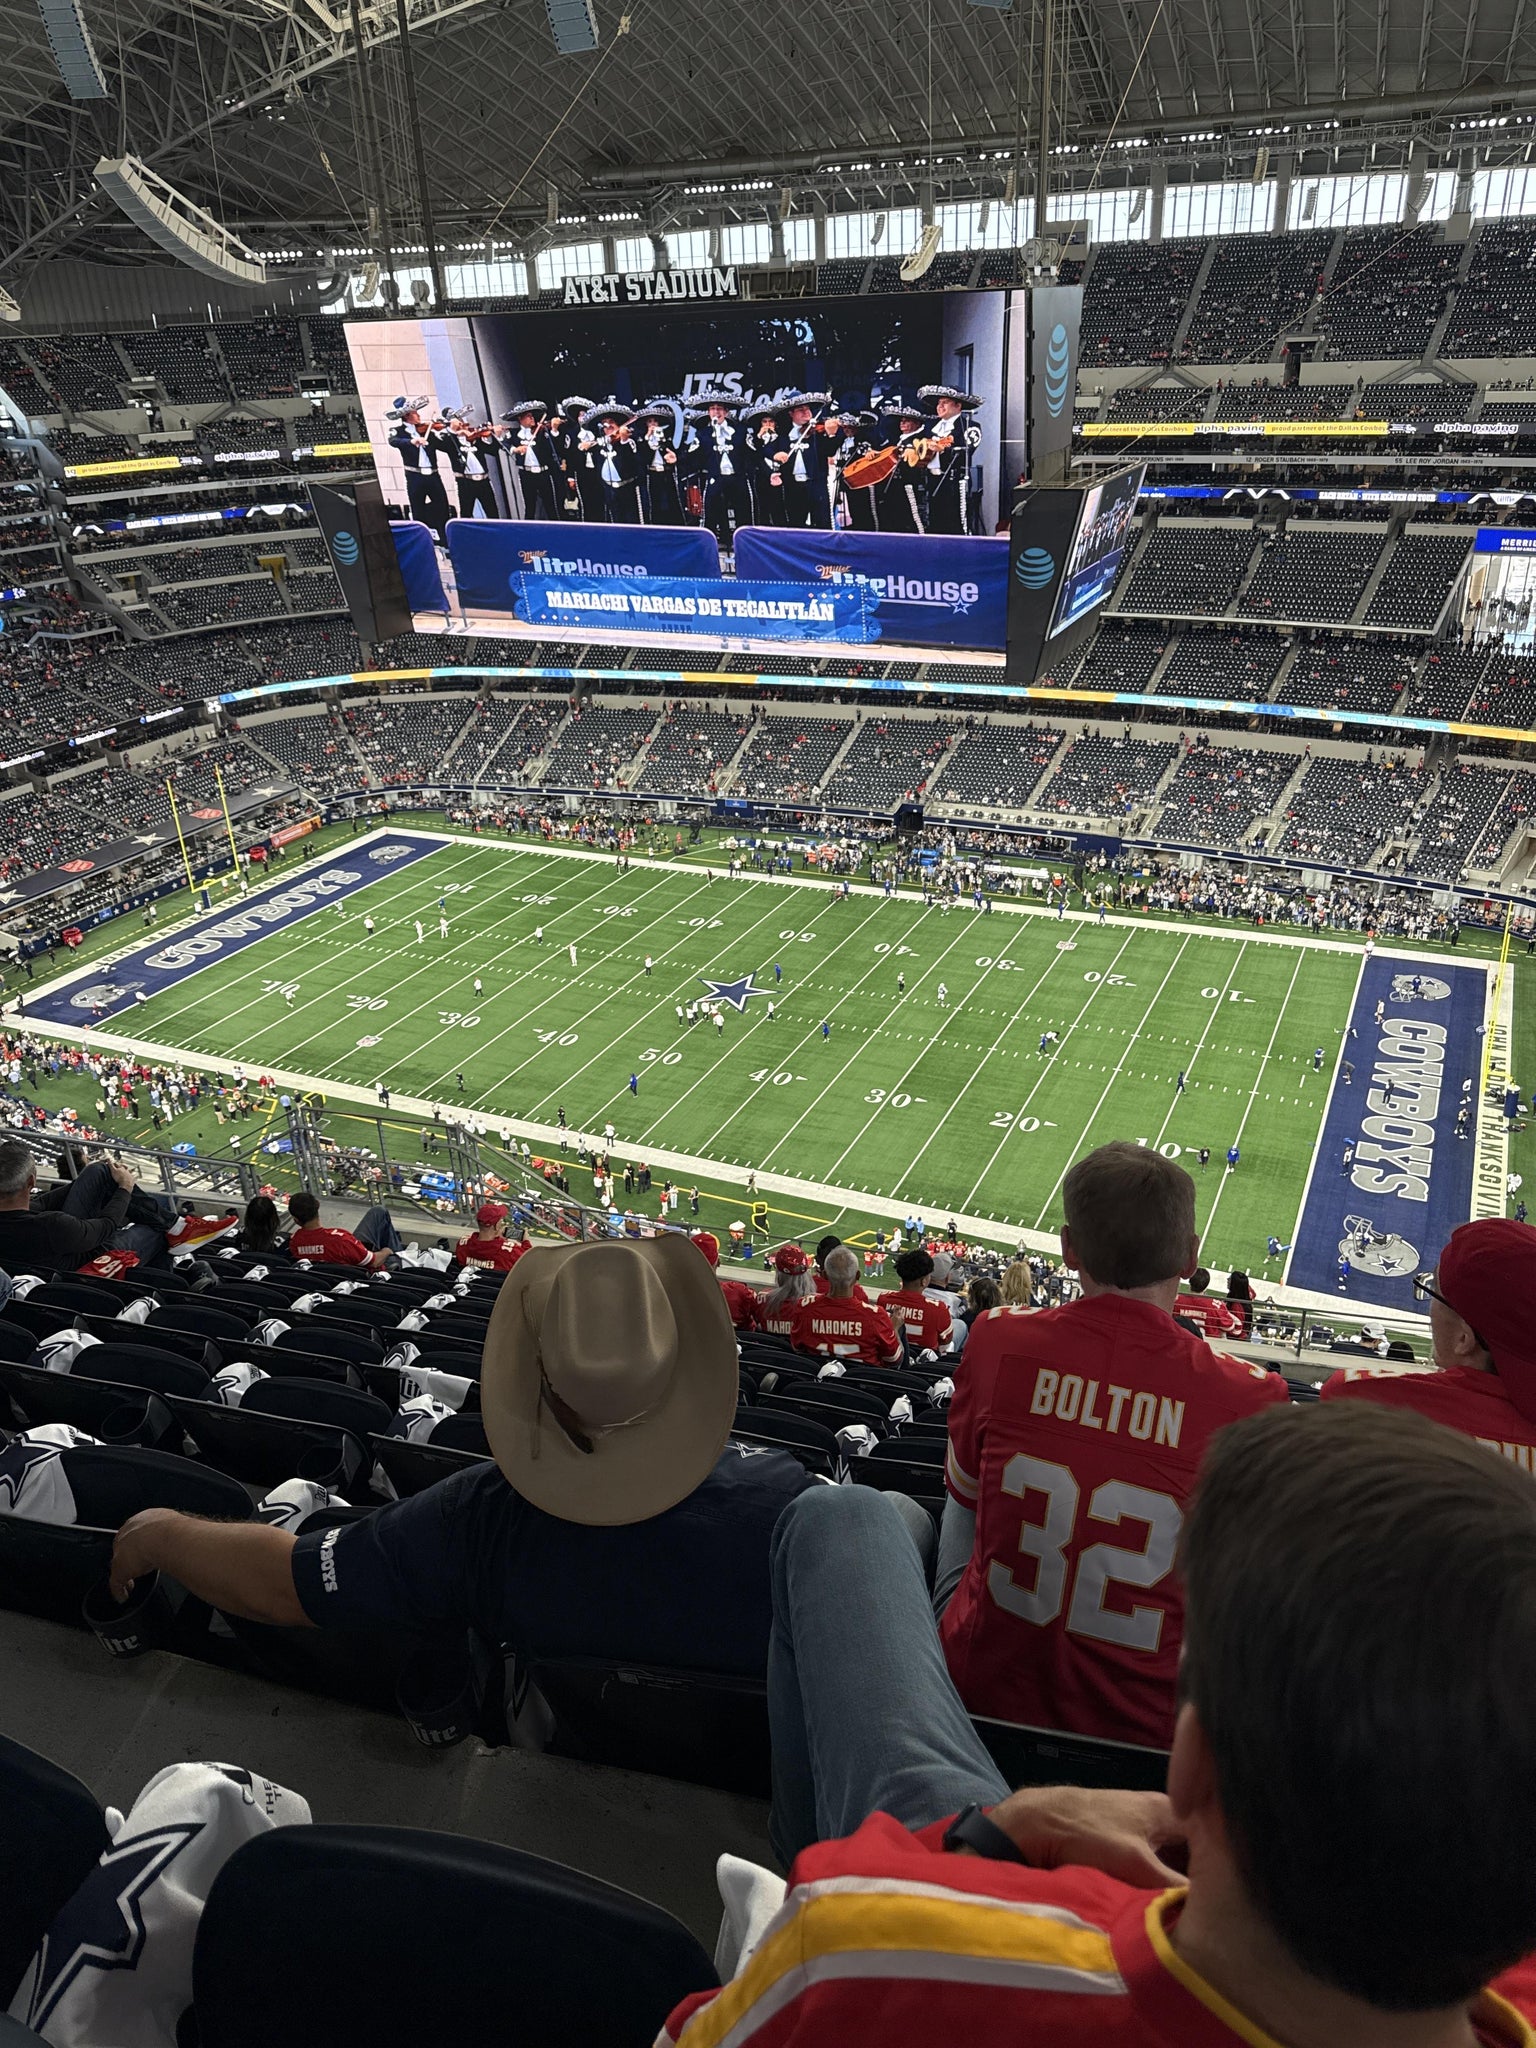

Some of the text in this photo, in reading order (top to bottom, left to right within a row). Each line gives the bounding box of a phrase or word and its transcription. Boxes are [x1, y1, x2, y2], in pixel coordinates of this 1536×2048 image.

[564, 266, 738, 304] AT&T STADIUM
[680, 371, 744, 400] IT'S
[1194, 424, 1265, 434] alpha paving
[1271, 425, 1291, 433] proud
[1434, 423, 1519, 435] alpha paving
[546, 591, 835, 622] MARIACHI VARGAS DE TECALITLÁN
[443, 882, 477, 894] 10
[521, 894, 558, 906] 20
[144, 869, 362, 969] COWBOYS
[602, 905, 639, 917] 30
[143, 909, 214, 943] MADDEN
[688, 917, 724, 929] 40
[778, 929, 817, 943] 50
[873, 942, 912, 956] 40
[975, 956, 1016, 971] 30
[1083, 971, 1127, 986] 20
[1200, 987, 1244, 1002] 10
[346, 995, 389, 1011] 20
[439, 1012, 481, 1028] 30
[537, 1030, 579, 1046] 40
[638, 1048, 683, 1065] 50
[748, 1068, 793, 1086] 40
[864, 1088, 912, 1108] 30
[1350, 1018, 1448, 1203] COWBOYS
[988, 1111, 1040, 1132] 20
[1476, 1114, 1504, 1218] THANKSGIVIN
[766, 1319, 794, 1335] MAHO
[811, 1318, 863, 1336] MAHOMES
[1030, 1367, 1186, 1449] BOLTON
[986, 1451, 1185, 1654] 32
[263, 1780, 274, 1815] THE
